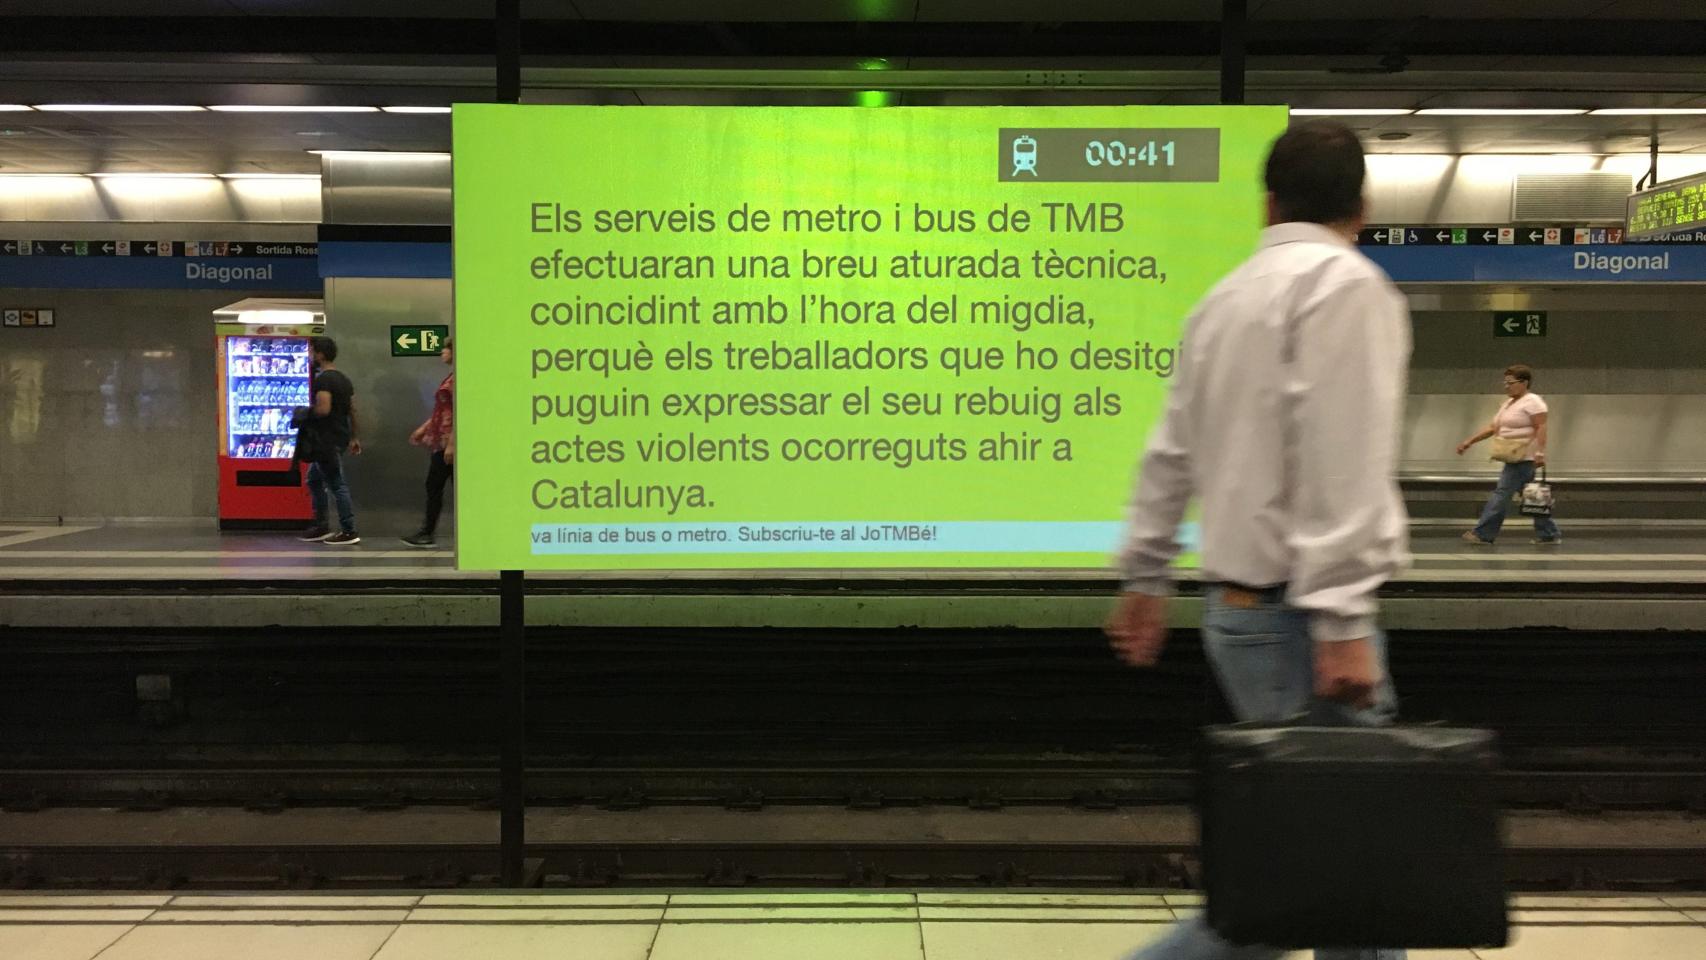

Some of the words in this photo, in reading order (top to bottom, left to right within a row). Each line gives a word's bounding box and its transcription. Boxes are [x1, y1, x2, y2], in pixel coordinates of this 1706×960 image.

[1085, 140, 1175, 167] 00:41
[531, 202, 582, 233] Els
[594, 202, 717, 233] serveis
[727, 202, 771, 233] de
[782, 203, 882, 233] metro
[894, 202, 901, 233] i
[914, 202, 976, 233] bus
[987, 202, 1031, 233] de
[1041, 202, 1125, 233] TMB
[256, 244, 293, 255] Sortida
[1452, 233, 1466, 244] L3
[1591, 232, 1606, 244] L6
[1608, 232, 1622, 243] L7
[75, 246, 89, 256] L3
[215, 246, 227, 256] L7
[1573, 251, 1669, 274] Diagonal
[185, 262, 273, 283] Diagonal
[530, 249, 715, 279] efectuaran
[727, 255, 791, 279] una
[802, 249, 878, 279] breu
[890, 248, 1021, 279] aturada
[1031, 248, 1167, 285] tècnica,
[530, 295, 701, 326] coincidint
[712, 294, 788, 325] amb
[800, 294, 896, 325] l’hora
[907, 294, 958, 325] del
[970, 294, 1095, 333] migdia,
[531, 339, 654, 379] perquè
[664, 340, 714, 371] els
[723, 339, 929, 371] treballadors
[939, 346, 1005, 378] que
[1016, 339, 1059, 371] ho
[1069, 339, 1185, 379] desitgi
[531, 386, 650, 426] puguin
[662, 392, 832, 424] expressar
[842, 386, 870, 416] el
[881, 392, 942, 416] seu
[954, 386, 1062, 424] rebuig
[1073, 386, 1122, 417] als
[530, 434, 626, 464] actes
[636, 432, 770, 463] violents
[781, 432, 968, 469] ocorreguts
[978, 431, 1043, 462] ahir
[1052, 438, 1073, 462] a
[531, 478, 715, 516] Catalunya.
[531, 531, 551, 544] va
[557, 527, 593, 544] línia
[598, 527, 619, 543] de
[624, 527, 656, 543] bus
[661, 530, 673, 543] o
[677, 528, 732, 543] metro.
[738, 525, 836, 542] Subscriu-te
[840, 525, 856, 541] al
[861, 524, 937, 541] JoTMBé!
